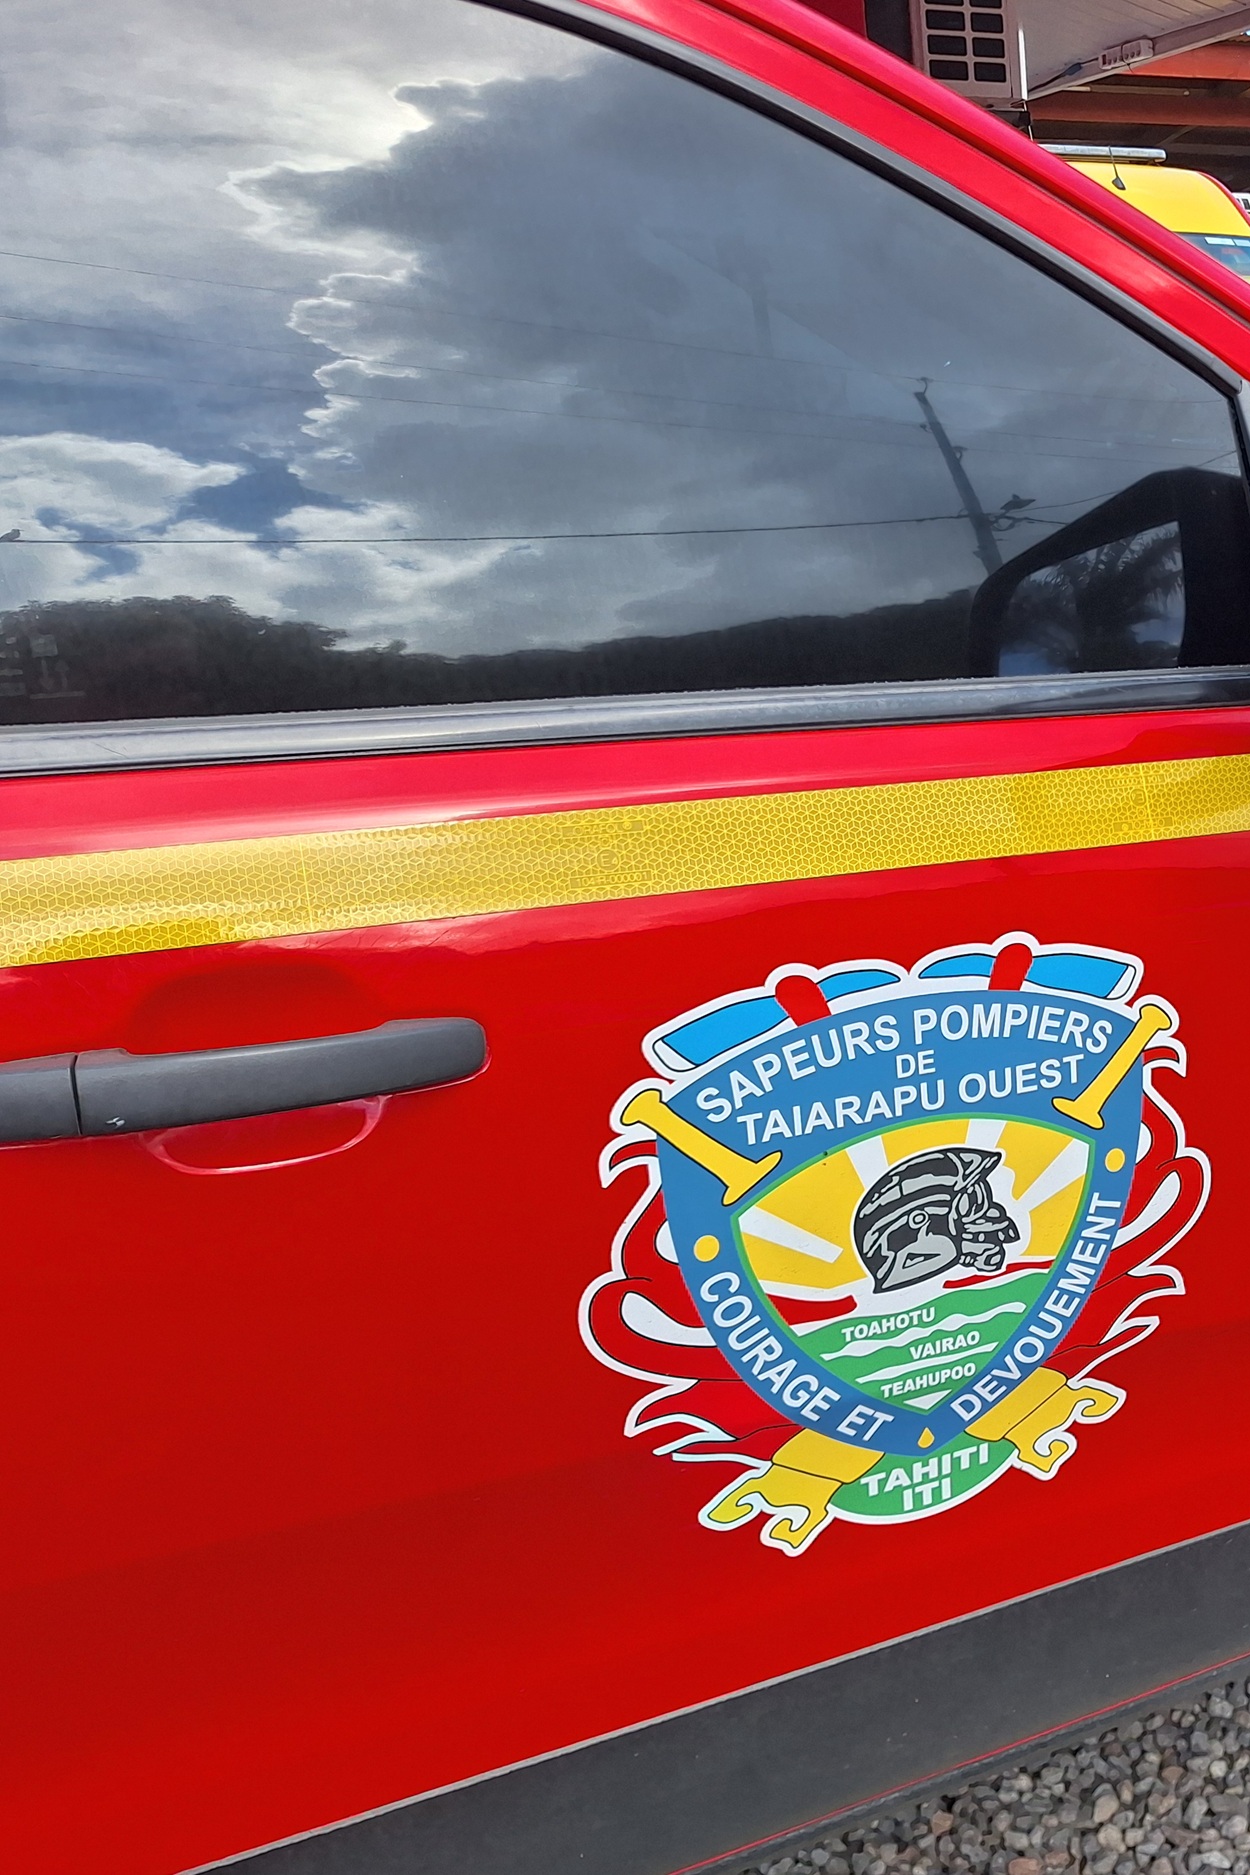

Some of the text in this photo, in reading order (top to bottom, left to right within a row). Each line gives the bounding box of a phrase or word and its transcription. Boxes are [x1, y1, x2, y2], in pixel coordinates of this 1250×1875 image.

[695, 1001, 1113, 1123] SAPEURS POMPIERS
[896, 1049, 937, 1079] DE
[736, 1054, 1085, 1145] TAIARAPU OUEST
[699, 1192, 1123, 1442] COURAGE ET DEVOUEMENT
[841, 1307, 936, 1342] TOAHOTU
[909, 1330, 980, 1360] VAIRAO
[880, 1362, 976, 1399] TEAHUPOO
[859, 1442, 990, 1498] TAHITI
[902, 1482, 952, 1514] ITI
